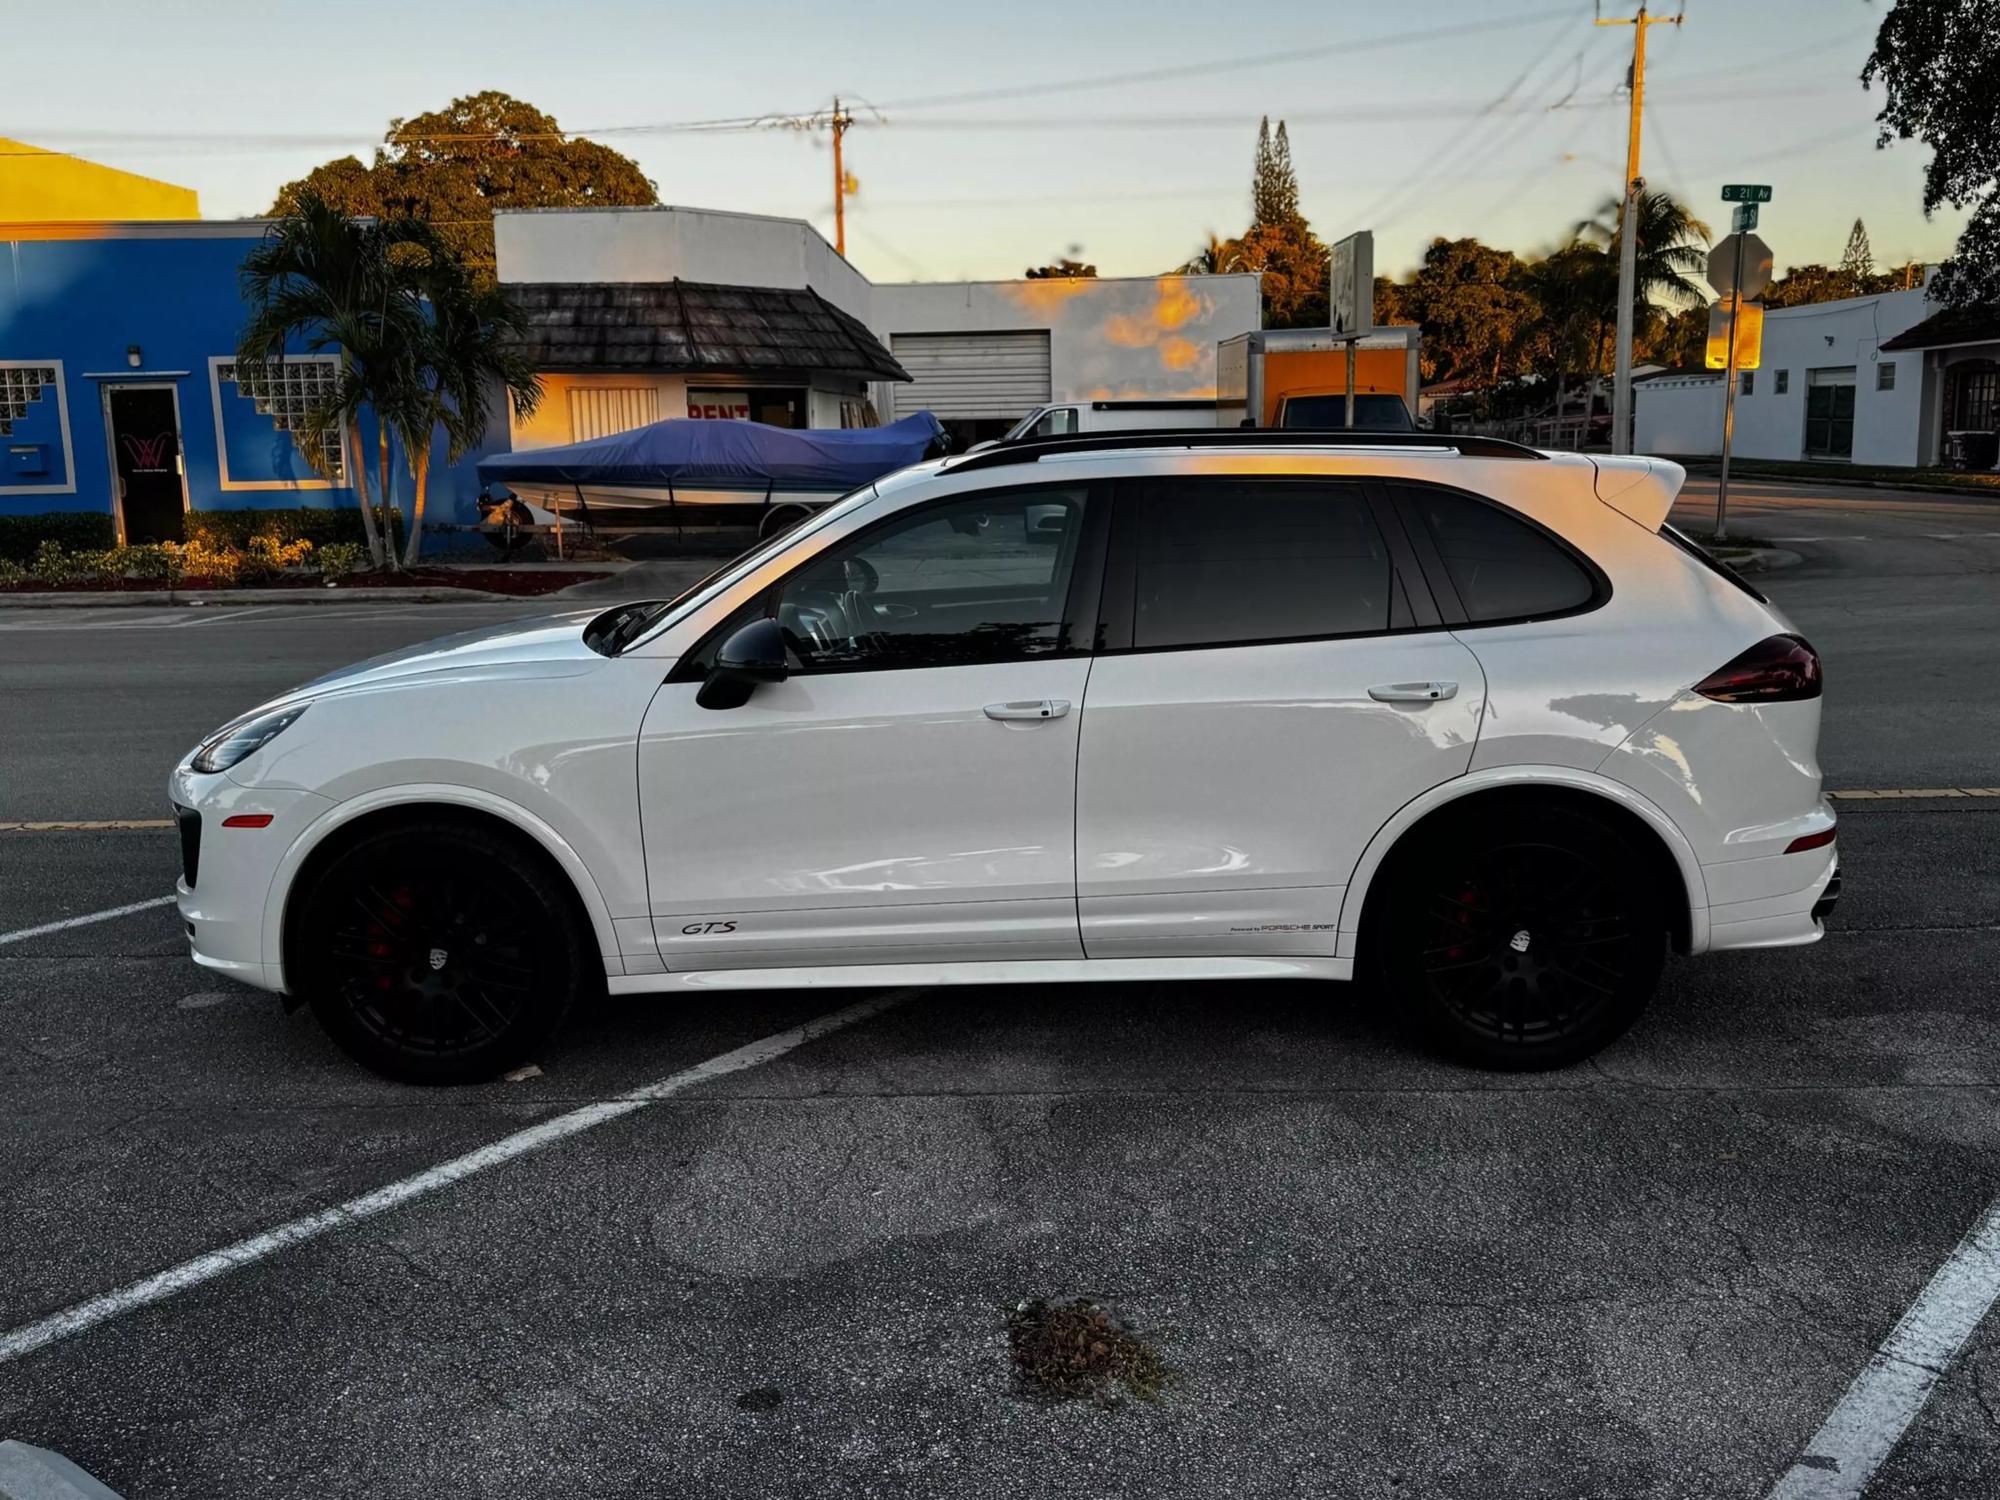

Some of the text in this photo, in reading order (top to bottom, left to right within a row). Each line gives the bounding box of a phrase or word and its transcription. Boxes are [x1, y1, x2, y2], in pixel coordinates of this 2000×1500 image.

[1724, 188, 1769, 199] S 21 Av
[682, 921, 738, 935] GTS
